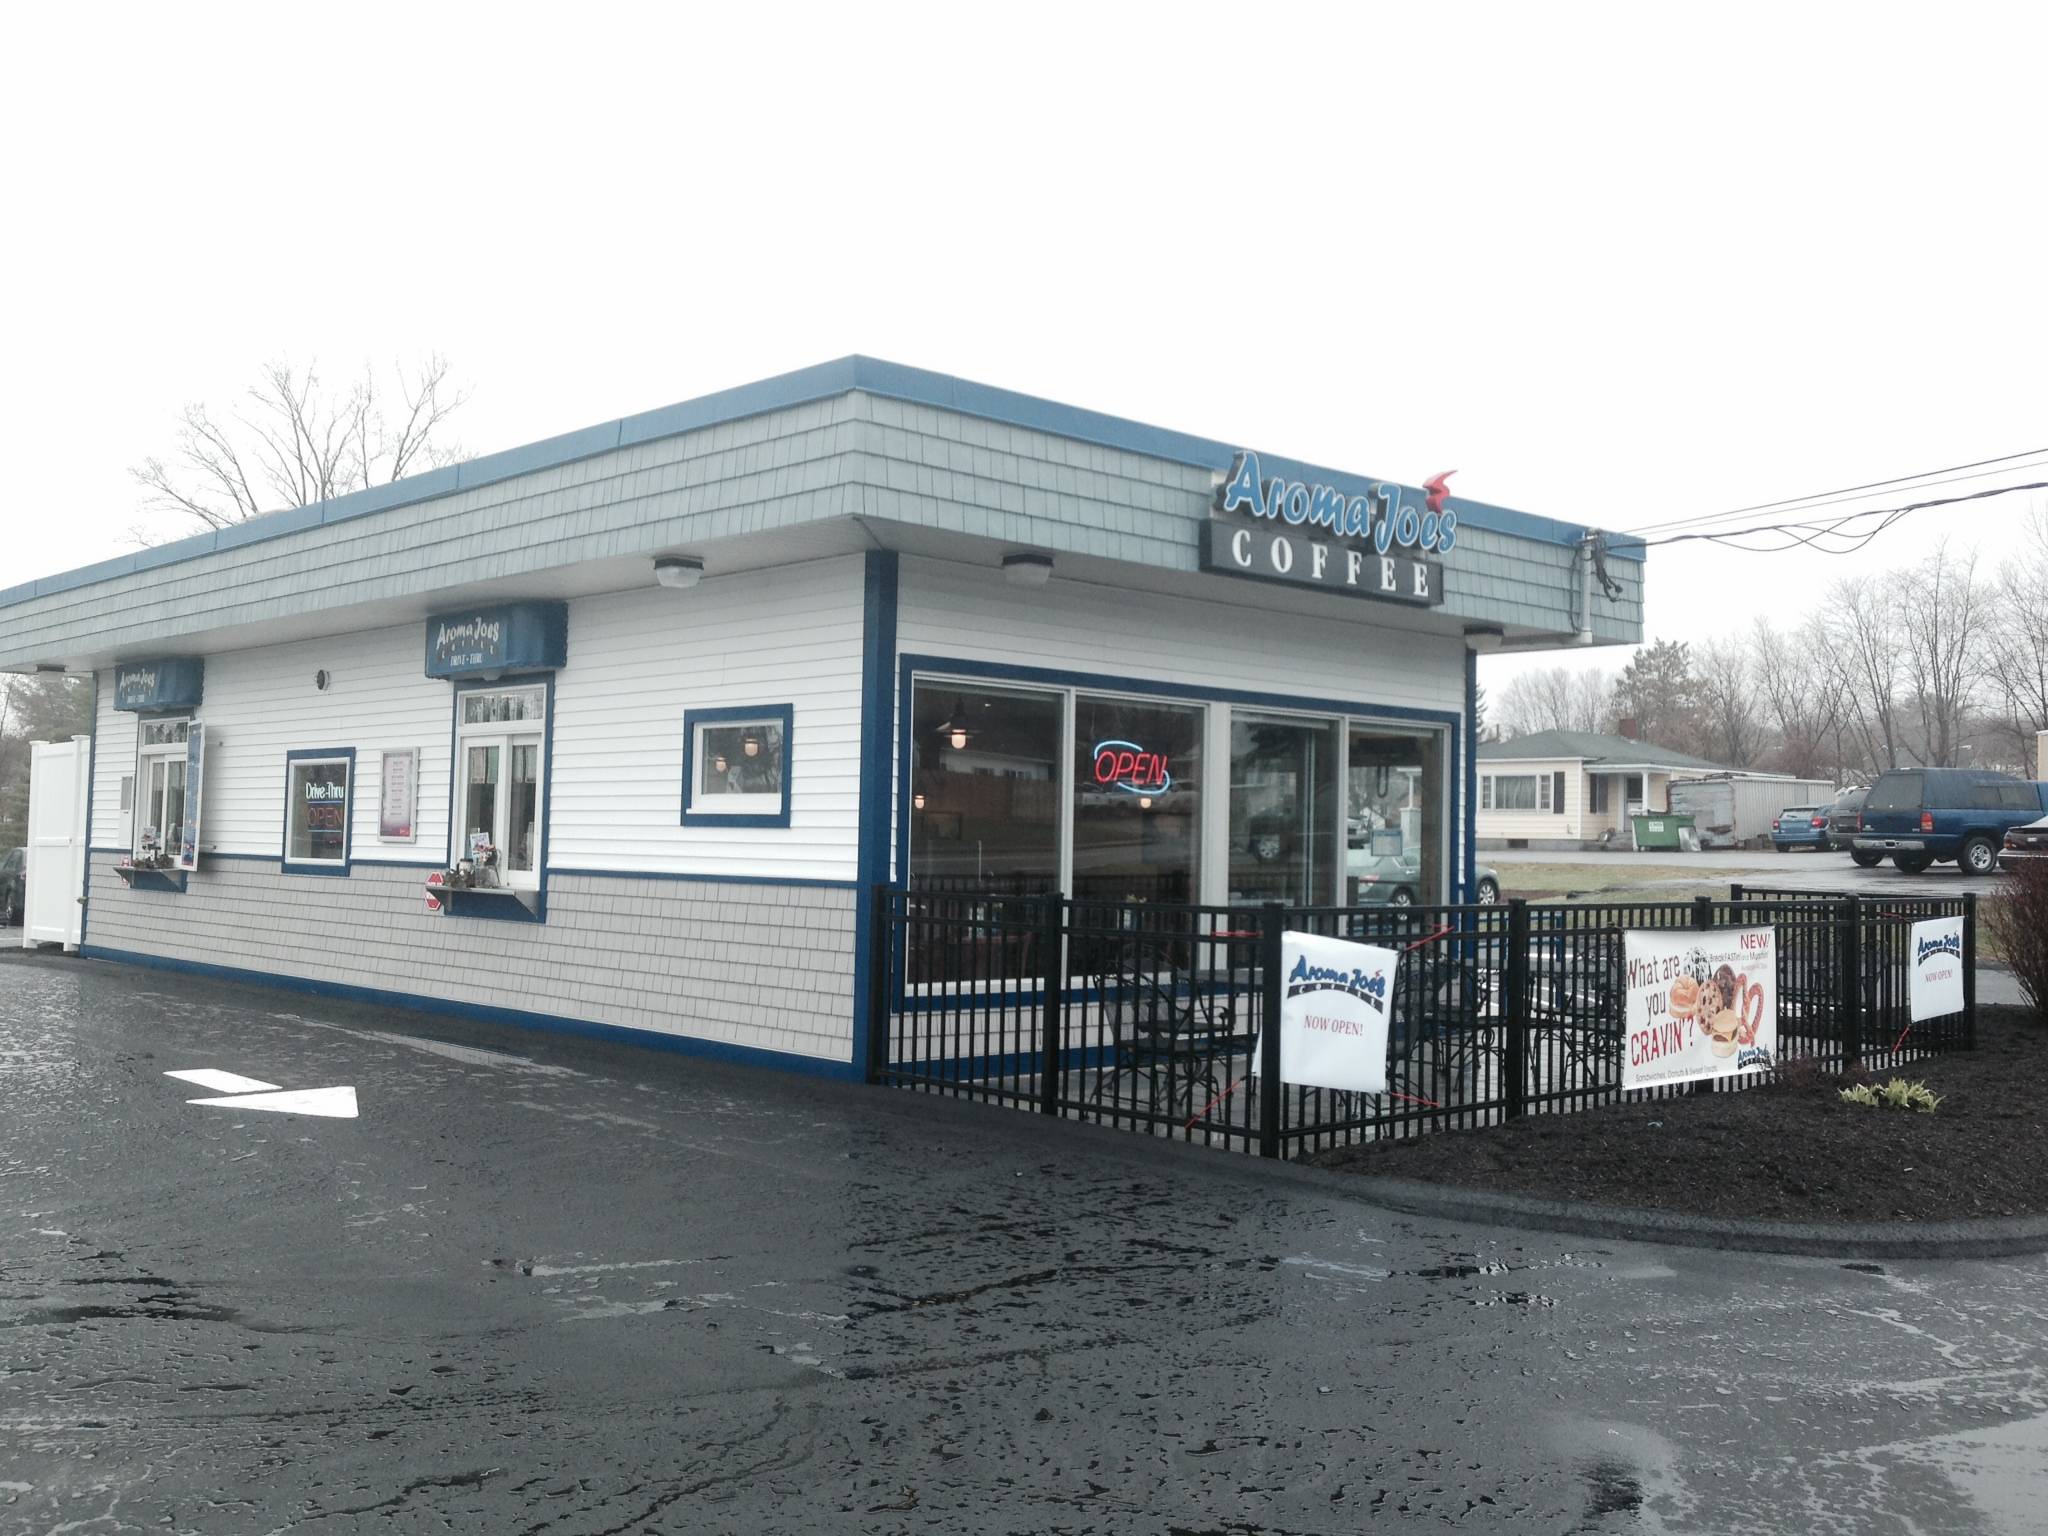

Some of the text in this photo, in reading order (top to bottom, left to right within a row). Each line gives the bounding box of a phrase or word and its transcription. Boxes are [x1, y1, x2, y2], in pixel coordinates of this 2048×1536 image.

[1224, 450, 1371, 538] Aroma
[1232, 529, 1429, 597] COFFEE
[436, 622, 474, 650] Aroma
[1095, 750, 1168, 785] OPEN
[305, 781, 344, 800] Drive-Thru
[308, 806, 343, 827] OPEN
[1740, 933, 1770, 950] NEW!
[1288, 954, 1348, 983] Aroma
[1627, 954, 1681, 990] What are
[1645, 991, 1666, 1027] you
[1304, 1014, 1364, 1036] NOW OPEN!
